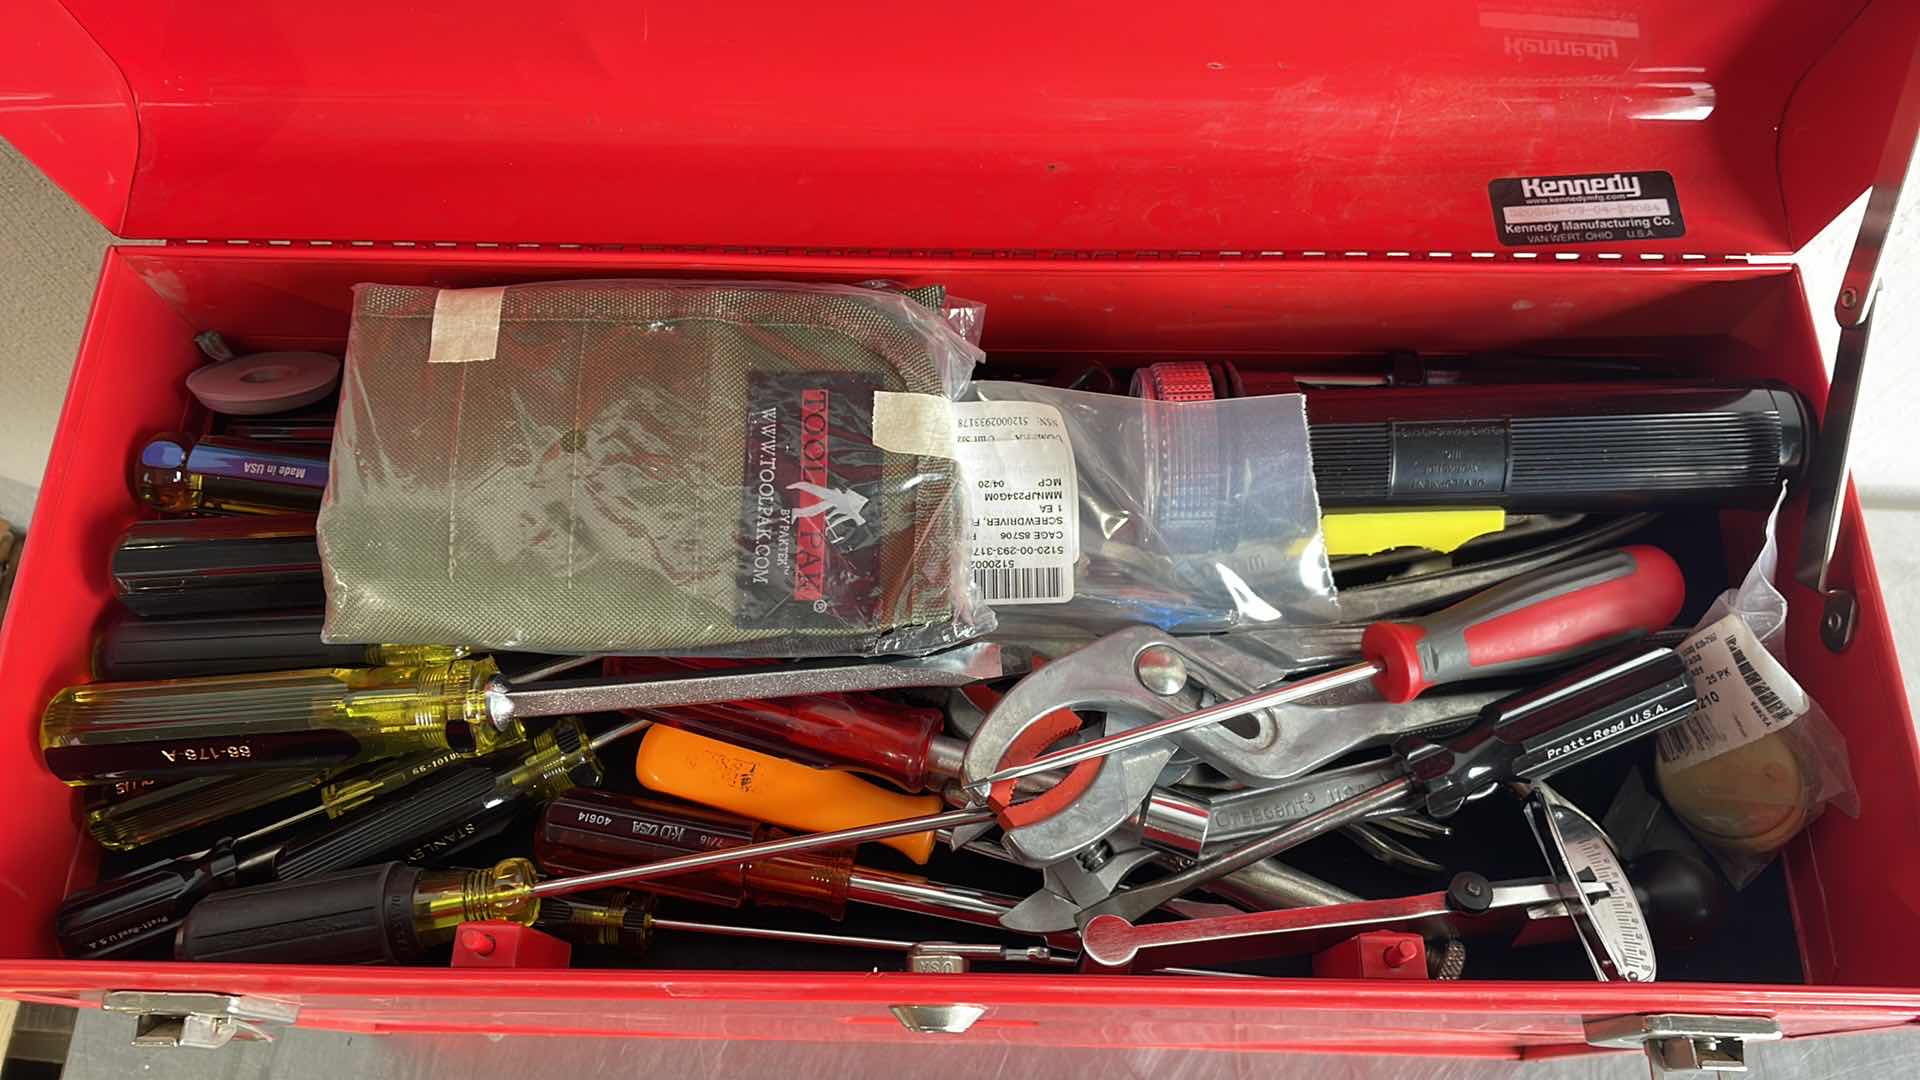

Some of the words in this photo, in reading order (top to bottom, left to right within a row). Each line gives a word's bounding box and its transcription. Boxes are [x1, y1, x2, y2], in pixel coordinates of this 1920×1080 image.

[1521, 174, 1641, 198] Kennedy
[1526, 194, 1626, 205] www.kennedymfg.com
[1505, 222, 1559, 234] Kennedy
[1562, 218, 1650, 231] Manufacturing
[1653, 216, 1675, 226] Co.
[1527, 234, 1548, 243] VAN
[1585, 231, 1613, 241] OHIO
[801, 391, 827, 482] TOOL
[243, 462, 265, 474] USA
[267, 465, 277, 476] in
[278, 466, 306, 479] Made
[978, 480, 1005, 489] 04/20
[1038, 478, 1062, 486] MCP
[753, 407, 777, 584] WWW.TOOLPAK.COM
[1039, 504, 1053, 513] EA
[779, 509, 790, 523] BY
[983, 516, 1063, 526] SCREWDRIVER,
[1034, 531, 1063, 540] CAGE
[971, 545, 1064, 556] 5120-00-293-317
[1546, 720, 1626, 759] Pratt-Read
[1629, 703, 1669, 730] U.S.A.
[578, 811, 612, 826] 40614
[404, 822, 477, 866] STANLEY
[919, 960, 953, 973] USA
